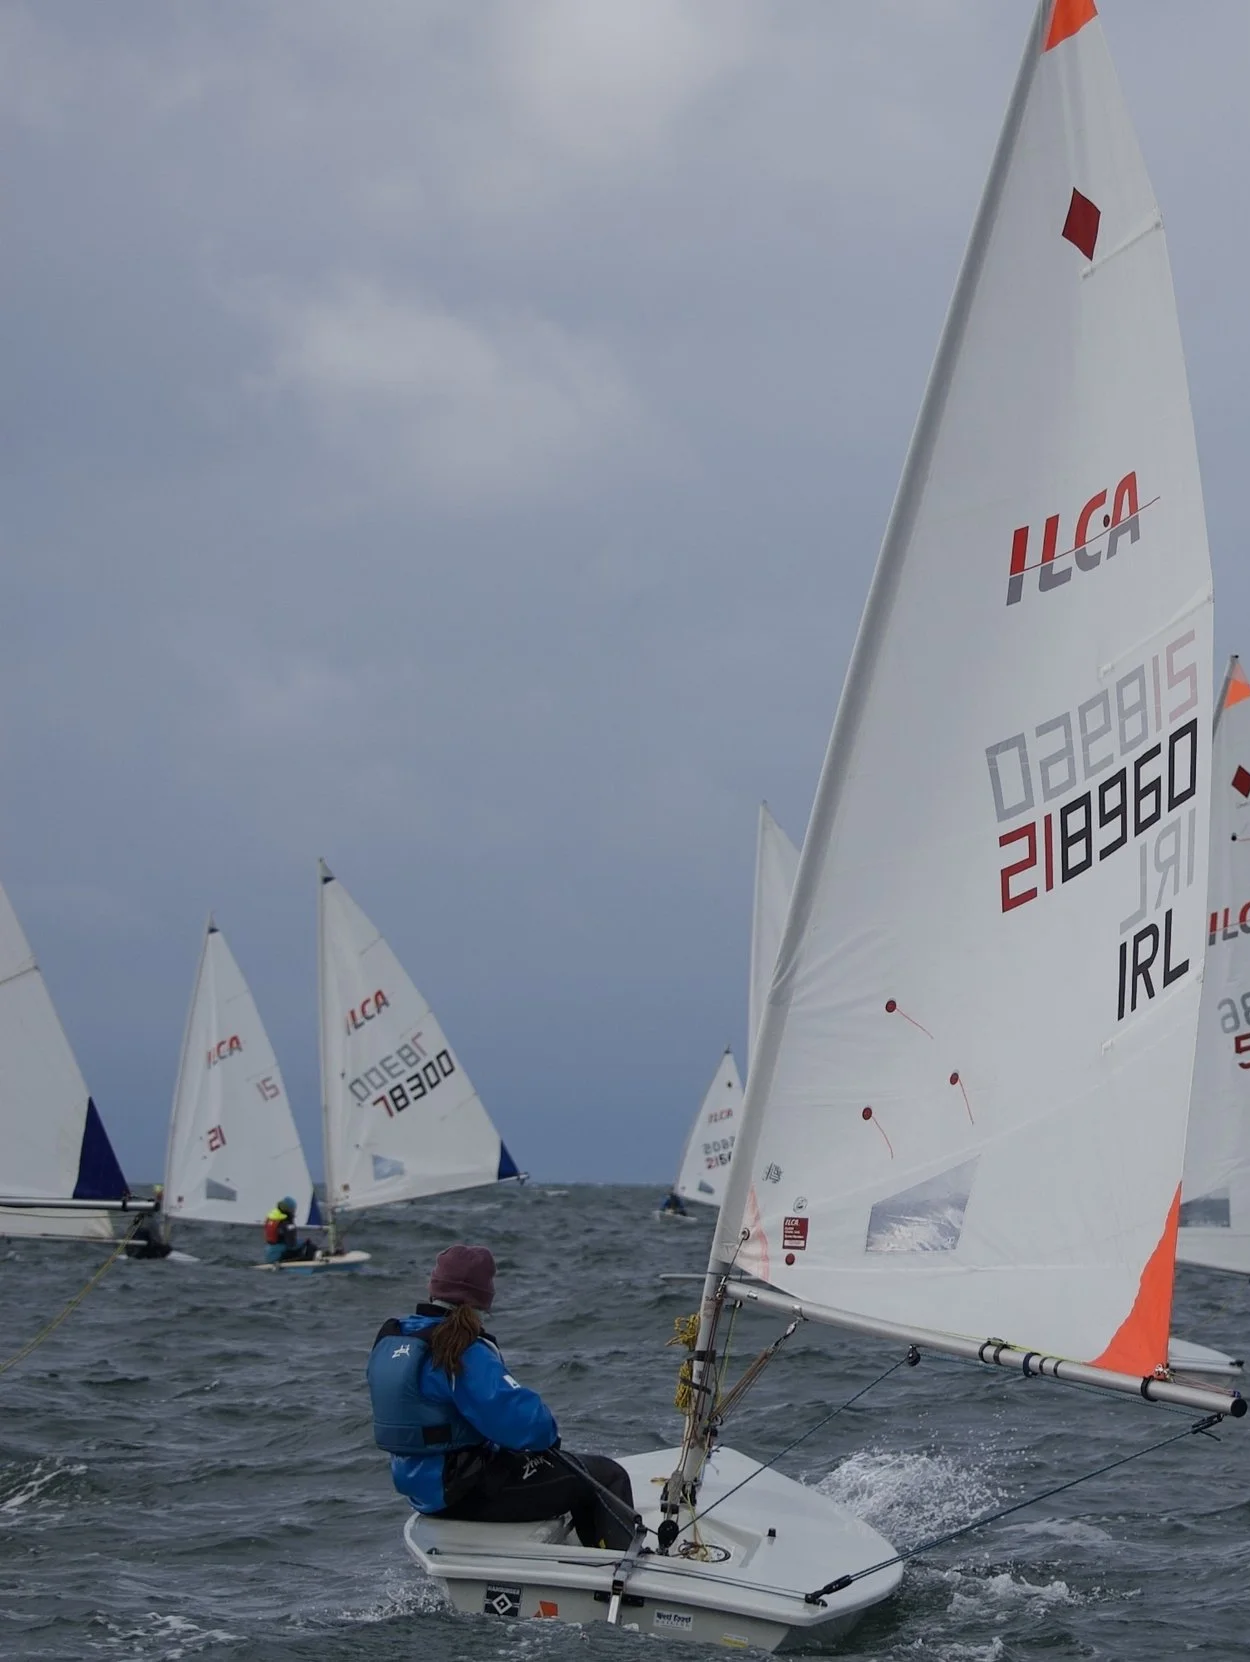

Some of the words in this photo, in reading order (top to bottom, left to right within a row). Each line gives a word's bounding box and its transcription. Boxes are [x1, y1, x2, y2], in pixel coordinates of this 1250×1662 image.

[1006, 470, 1141, 606] ILCA
[999, 717, 1198, 913] 218960
[1117, 908, 1190, 1021] IRL
[345, 989, 390, 1036] ILCA
[206, 1034, 243, 1070] ILCA
[372, 1049, 455, 1118] 78300
[207, 1124, 227, 1152] 21
